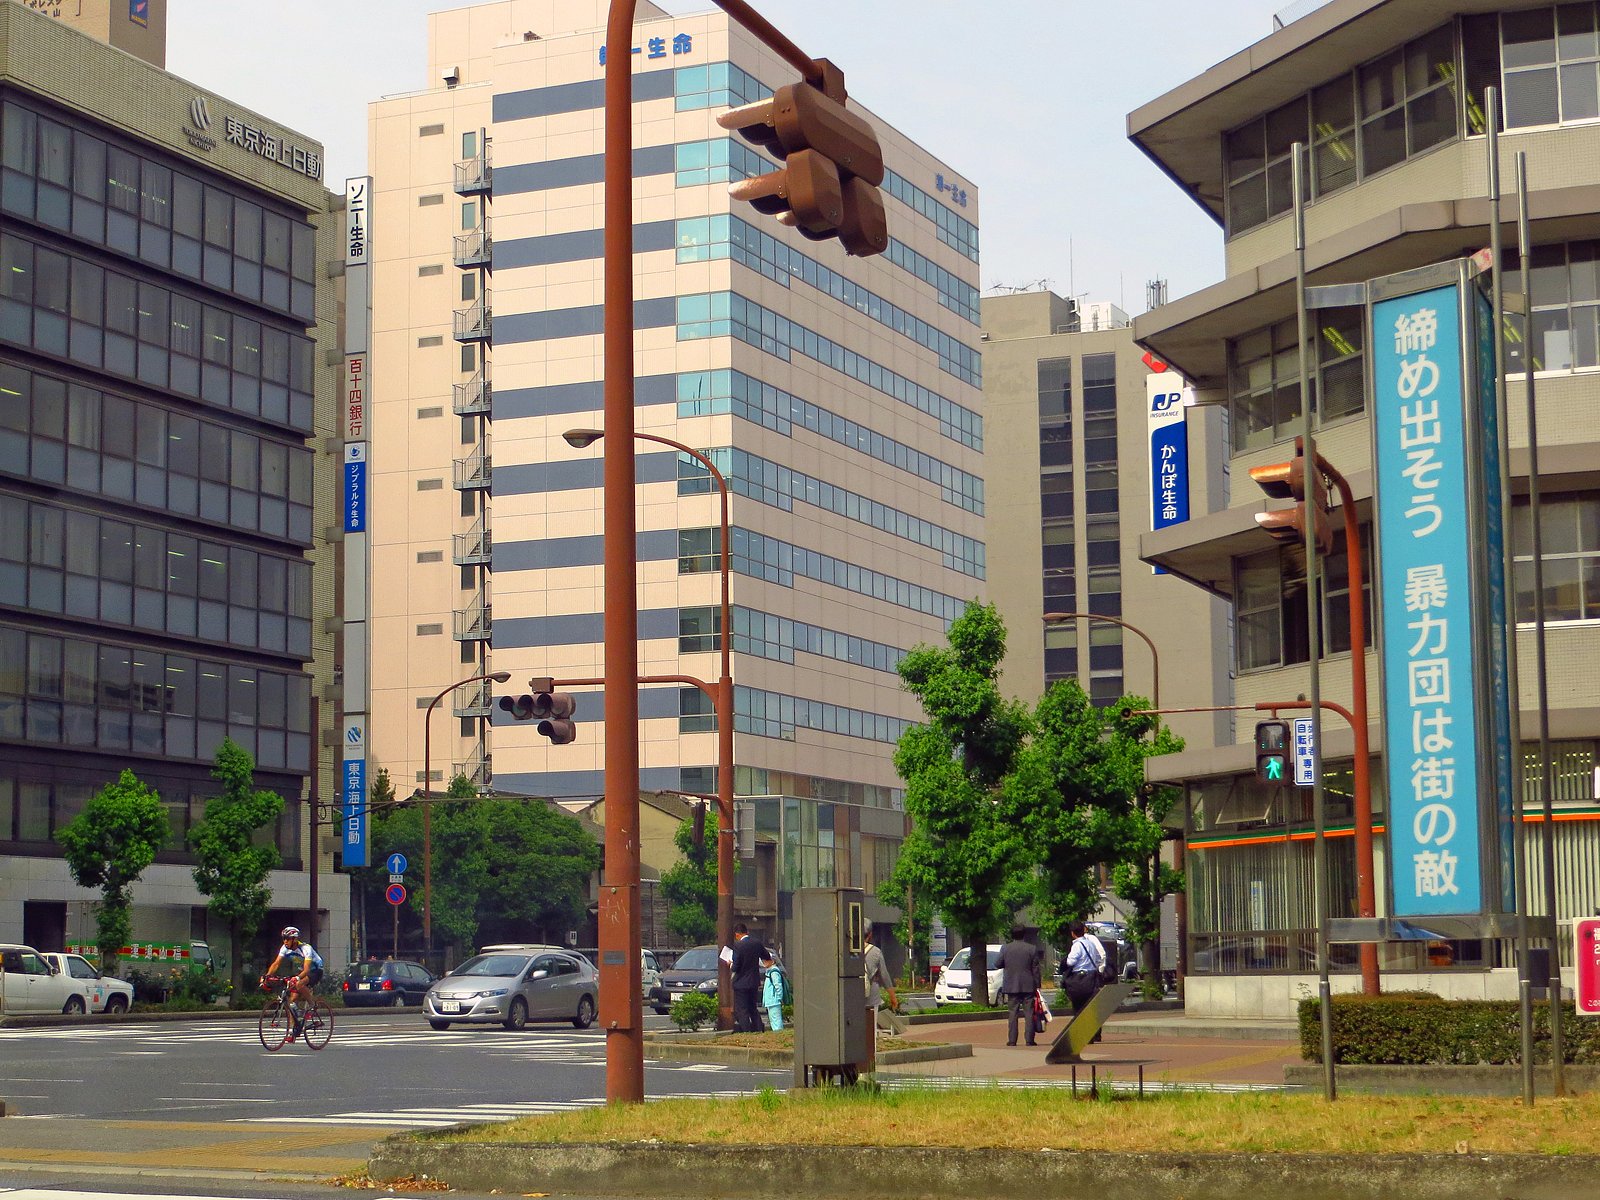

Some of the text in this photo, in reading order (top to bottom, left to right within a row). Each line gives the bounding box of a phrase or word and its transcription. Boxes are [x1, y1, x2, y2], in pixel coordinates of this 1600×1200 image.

[225, 115, 321, 181] 東京海上日動
[349, 184, 364, 258] ソニー生命
[349, 358, 363, 437] 百十四銀行
[1150, 410, 1179, 418] INSURANCE
[351, 465, 360, 527] ジブラルタ生命
[1160, 444, 1177, 520] かんぽ生命
[1393, 307, 1460, 898] 締め出そう 暴力団は街の敵
[347, 762, 360, 845] 東京海上日動
